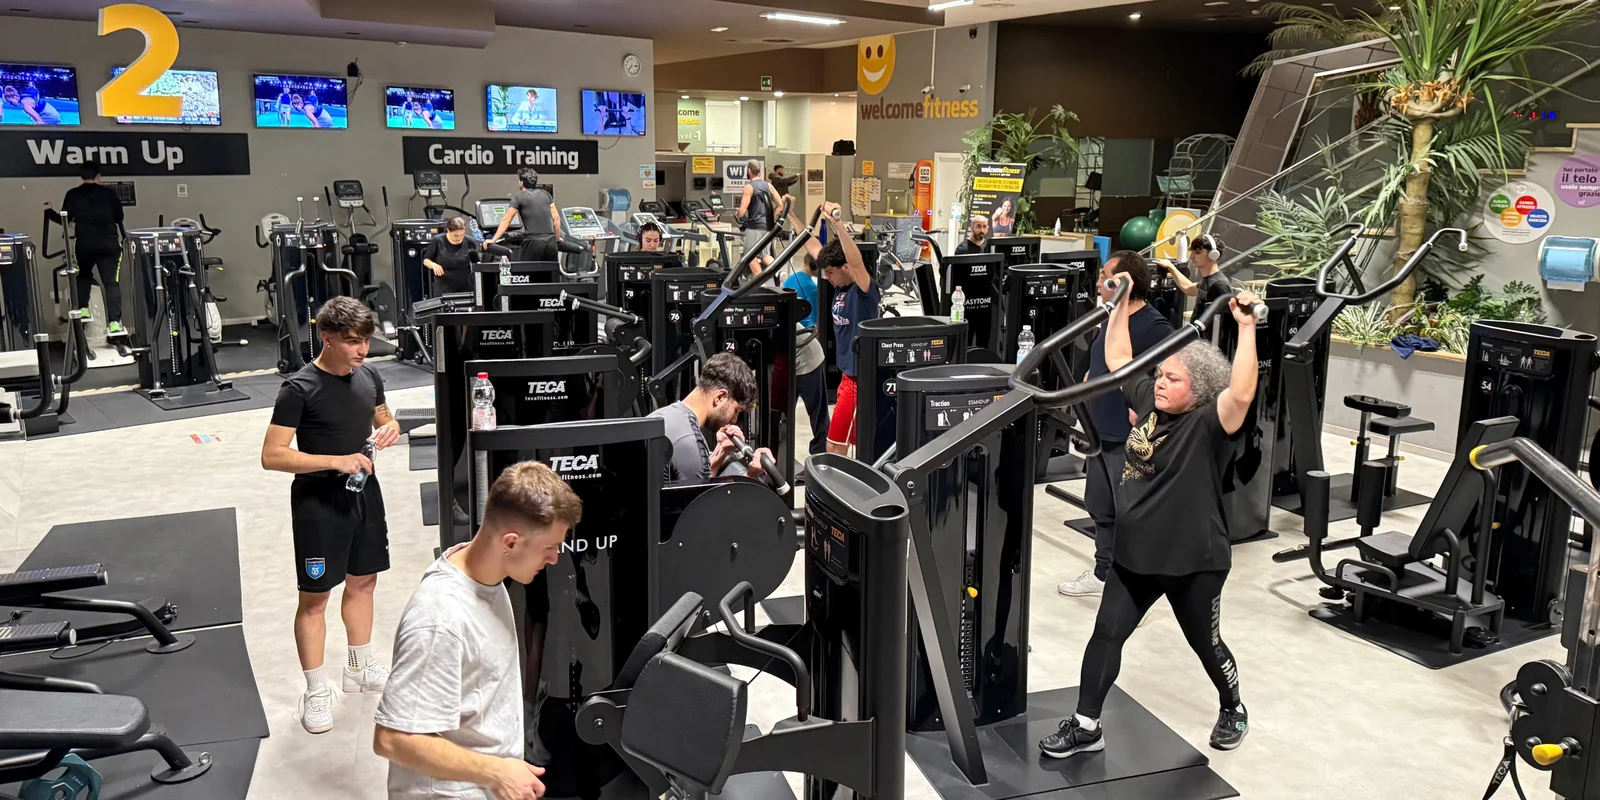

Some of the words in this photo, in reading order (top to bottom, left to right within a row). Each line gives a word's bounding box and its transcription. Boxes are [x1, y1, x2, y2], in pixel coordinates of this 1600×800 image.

[96, 4, 183, 117] 2
[860, 94, 979, 120] welcomefitness
[27, 139, 129, 165] Warm
[142, 140, 184, 170] Up
[428, 144, 494, 166] Cardio
[502, 145, 579, 170] Training
[1561, 173, 1569, 183] il
[1573, 173, 1597, 184] telo
[971, 265, 987, 273] TECA
[539, 298, 564, 307] TECA
[1028, 309, 1037, 317] 51
[481, 329, 513, 340] TECA
[1288, 327, 1298, 335] 60
[725, 342, 736, 351] 74
[1533, 349, 1551, 357] TECA
[527, 380, 567, 394] TECA
[886, 382, 896, 392] 71
[1480, 381, 1492, 391] 54
[549, 454, 599, 472] TECA
[556, 538, 589, 554] ND
[595, 534, 618, 550] UP
[1220, 658, 1238, 689] HATE
[1491, 760, 1511, 784] TECA
